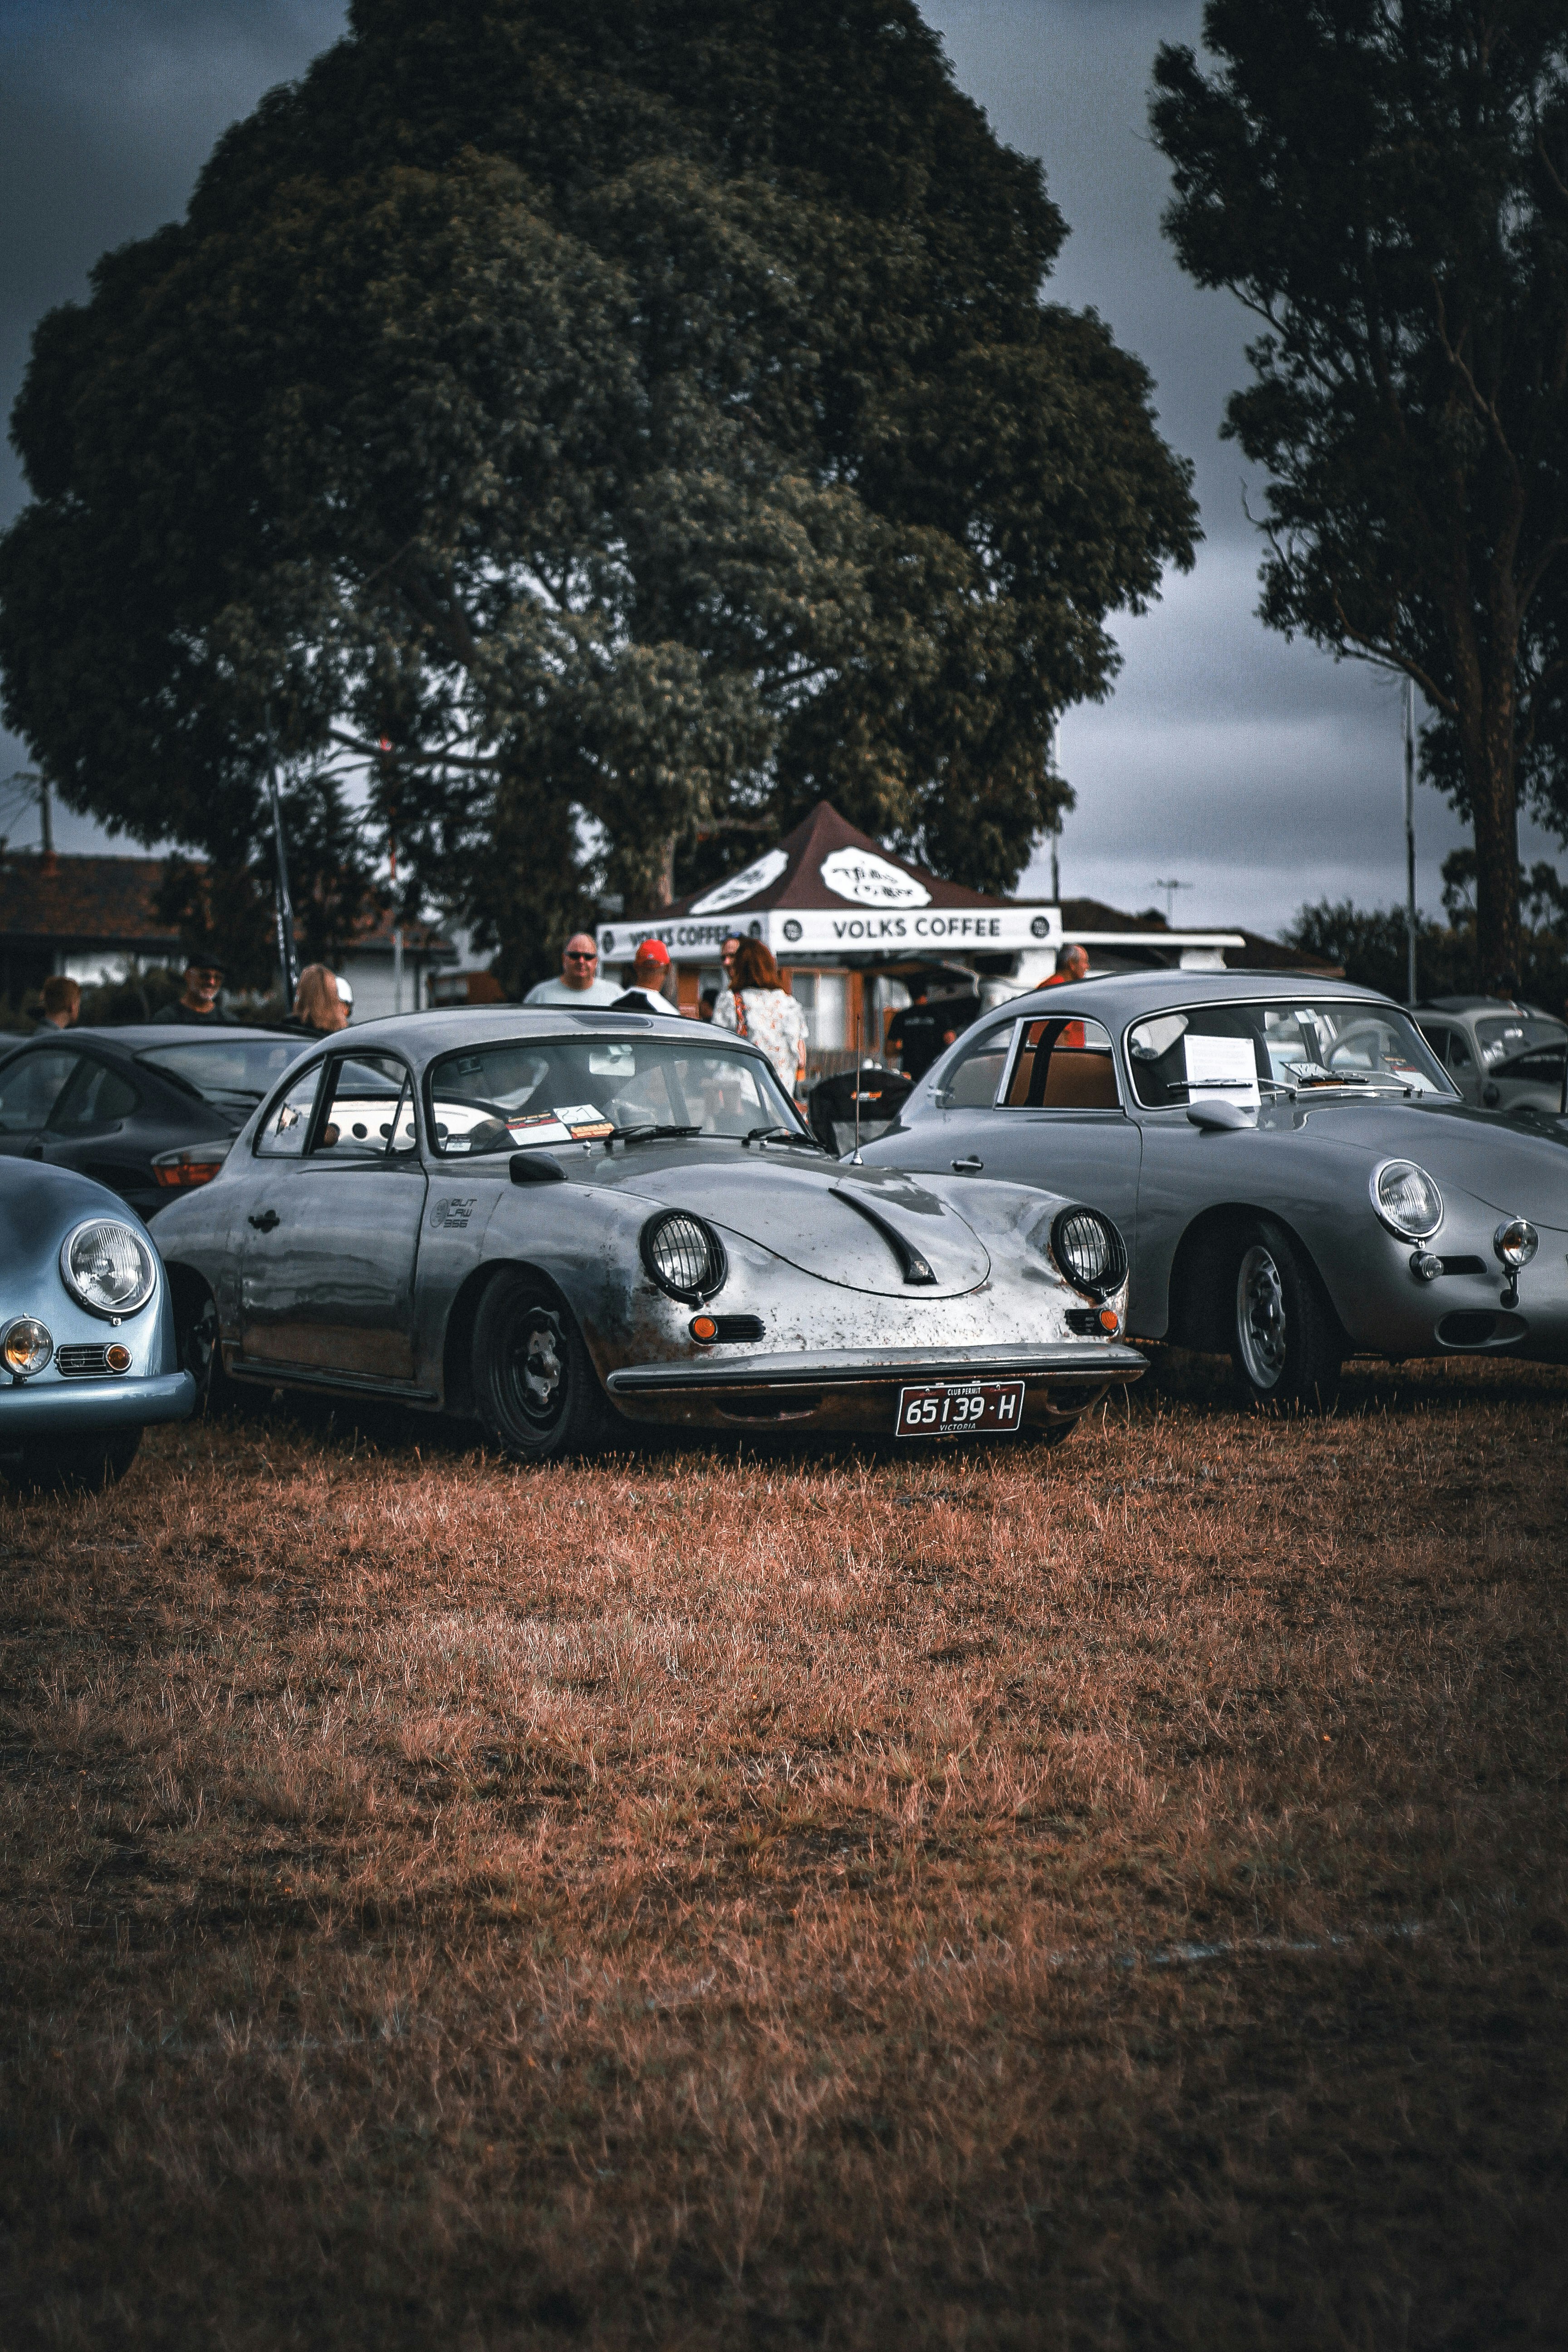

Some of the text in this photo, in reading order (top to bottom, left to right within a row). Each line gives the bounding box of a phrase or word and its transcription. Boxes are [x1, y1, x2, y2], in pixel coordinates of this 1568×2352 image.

[833, 917, 1000, 939] VOLKS COFFEE
[556, 1107, 602, 1122] 81
[446, 1208, 473, 1216] LAW
[443, 1219, 469, 1228] 356
[940, 1423, 976, 1431] VICTORIA
